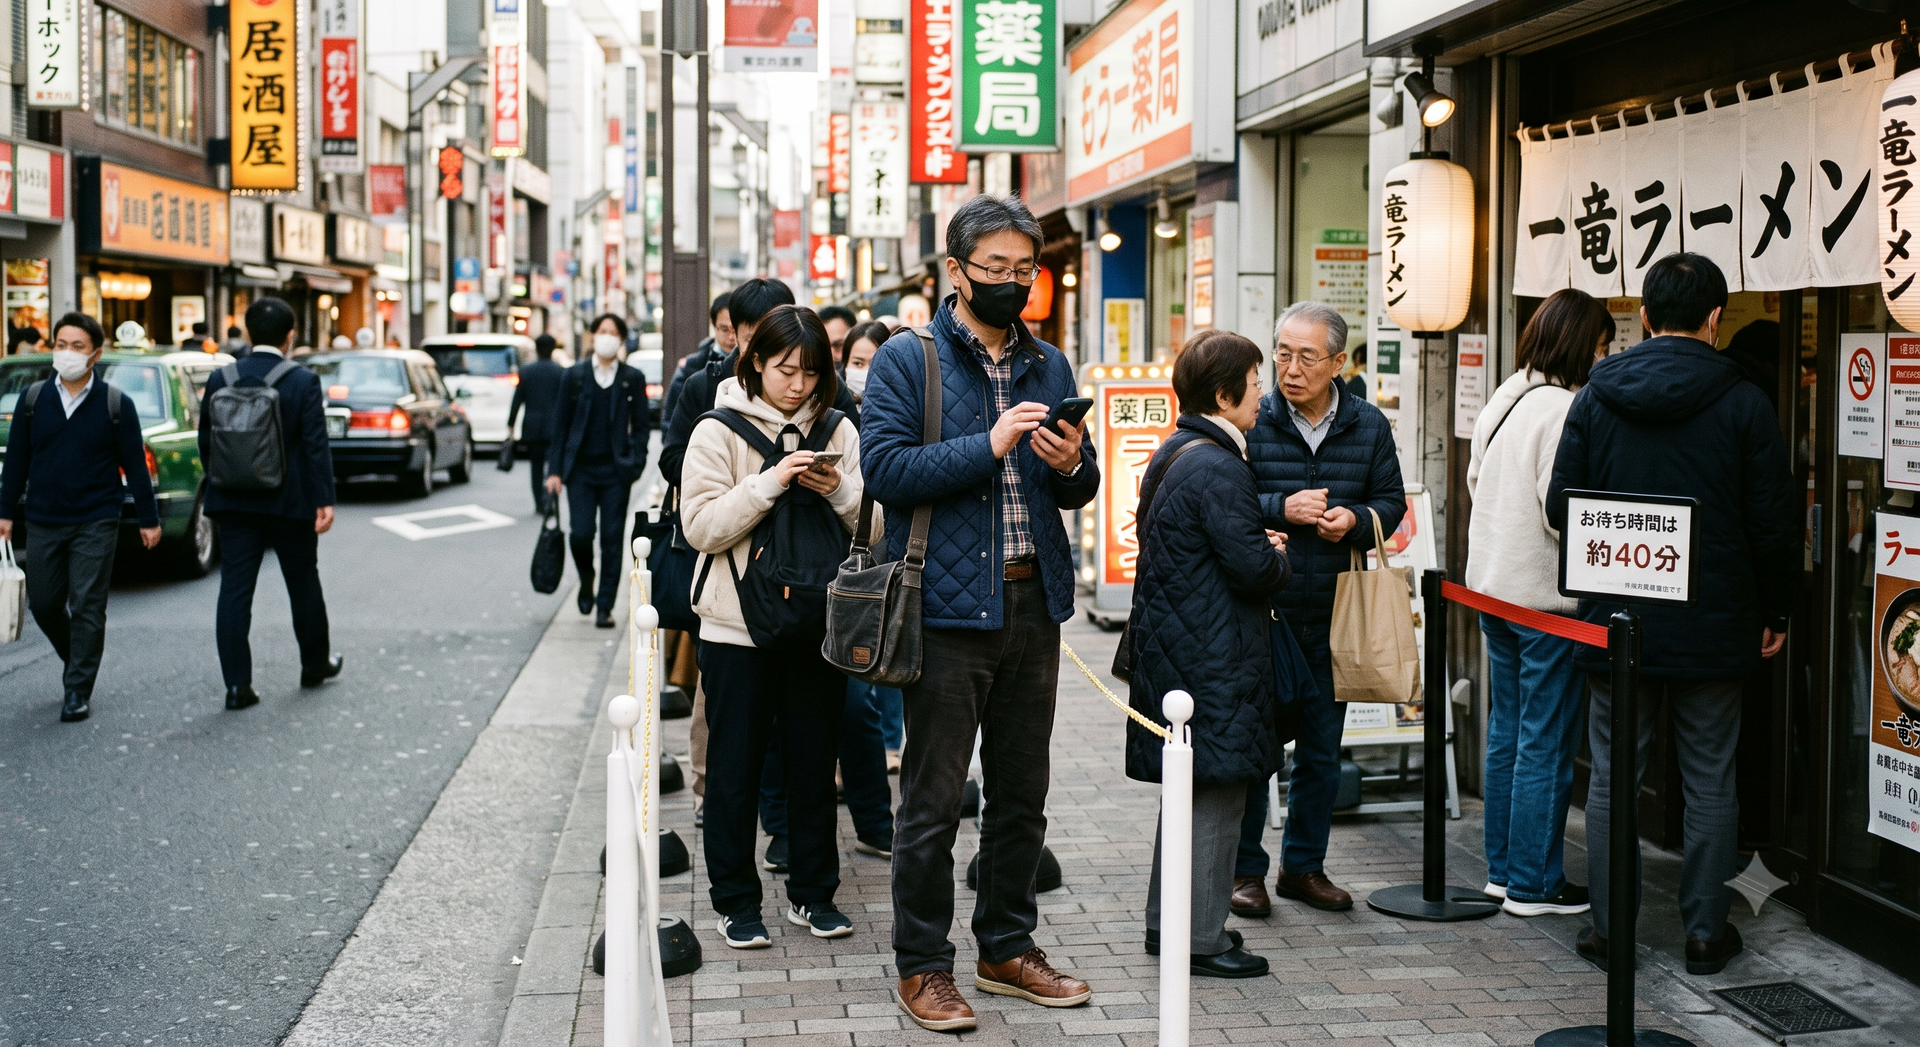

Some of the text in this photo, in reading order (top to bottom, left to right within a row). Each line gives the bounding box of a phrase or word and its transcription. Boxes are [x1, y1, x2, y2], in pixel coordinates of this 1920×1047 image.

[241, 20, 286, 167] 居酒屋
[975, 1, 1042, 137] 薬局
[1384, 179, 1409, 307] 一竜ラーメン
[1528, 160, 1871, 276] 一竜ラーメン
[1879, 95, 1918, 301] 一竜ラーメン
[1113, 397, 1168, 424] 薬局
[1580, 510, 1678, 533] お待ち時間は
[1586, 539, 1681, 573] 約40分
